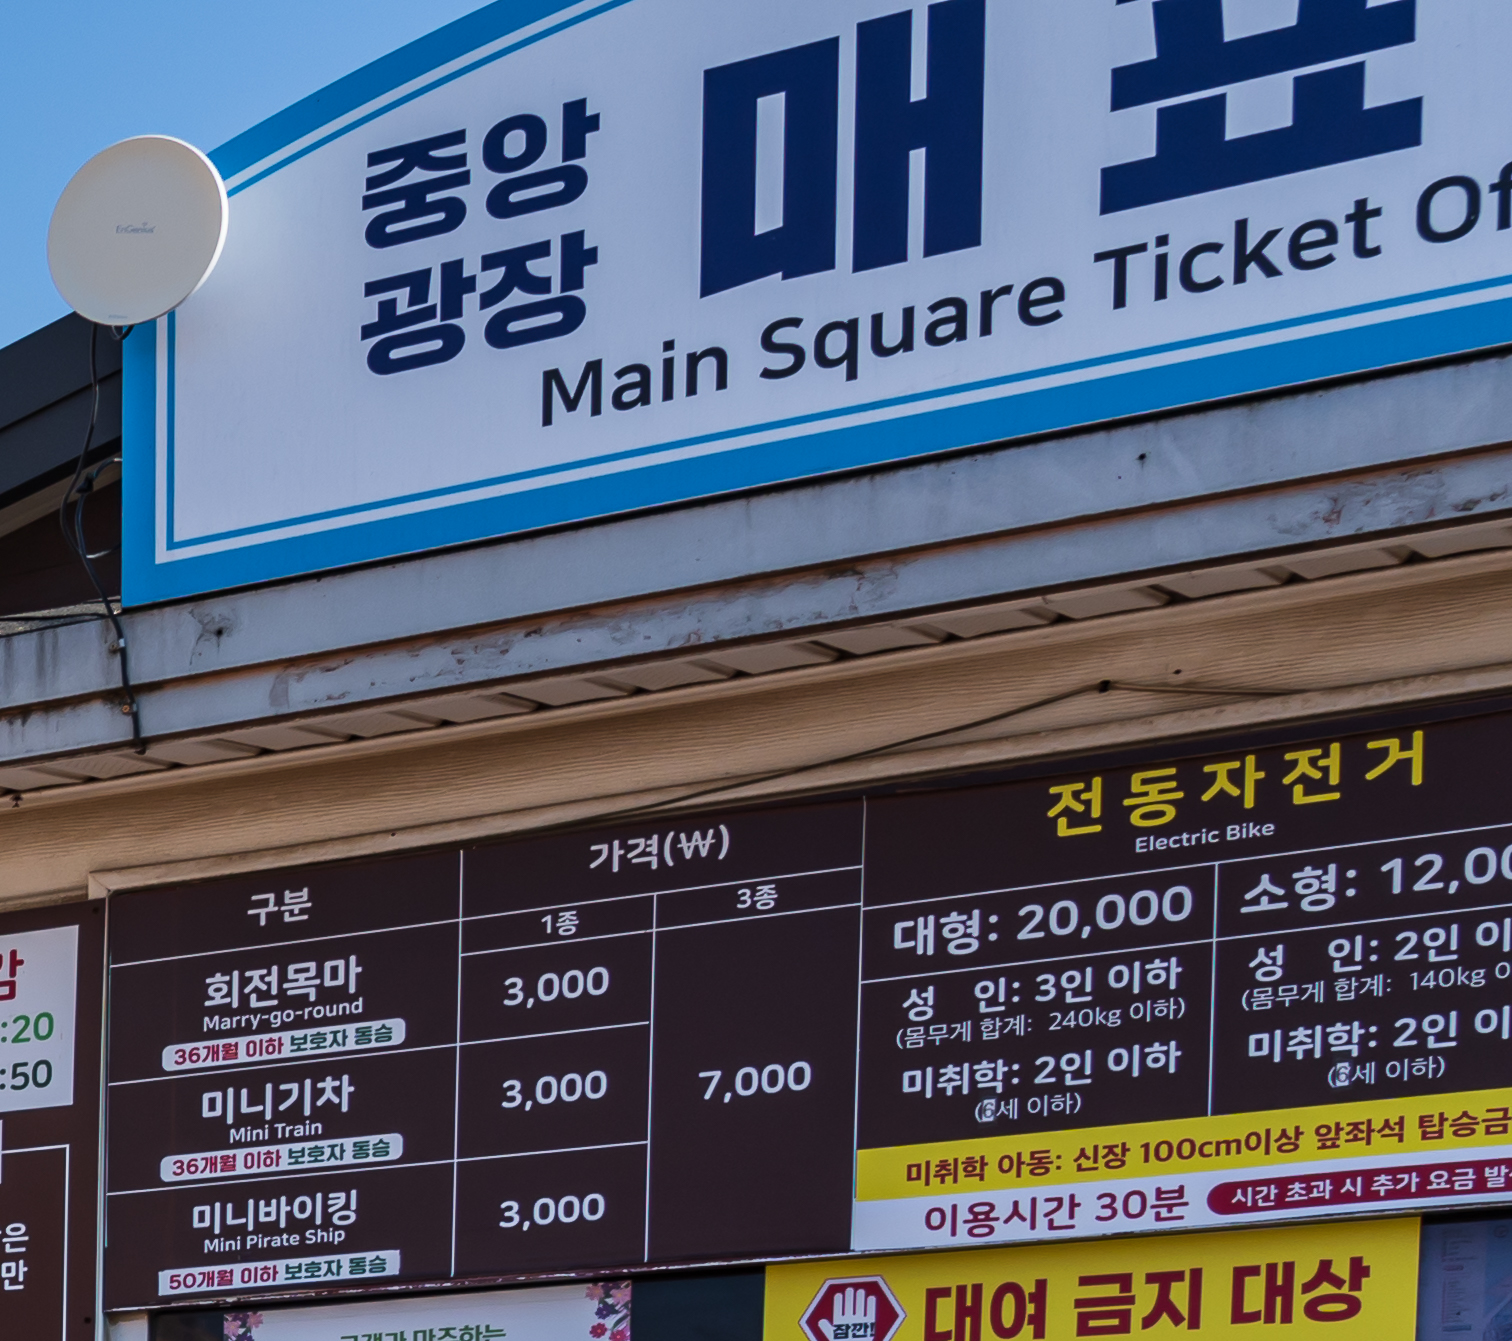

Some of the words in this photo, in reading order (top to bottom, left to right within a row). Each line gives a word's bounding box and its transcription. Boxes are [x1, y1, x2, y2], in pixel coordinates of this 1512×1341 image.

[360, 97, 600, 251] 중앙
[359, 230, 598, 377] 광장
[540, 340, 729, 428] Main
[757, 272, 1066, 379] Square
[1093, 194, 1383, 311] Ticket
[1047, 730, 1423, 837] 전동자전거
[1135, 827, 1220, 853] Electric
[1225, 821, 1276, 842] Bike
[247, 888, 312, 926] 구분
[737, 884, 778, 910] 3종
[1240, 863, 1356, 912] 소형:
[541, 911, 579, 935] 1종
[893, 909, 998, 956] 대형:
[1016, 885, 1192, 941] 20,000
[204, 955, 362, 1008] 회전목마
[503, 966, 610, 1009] 3,000
[902, 985, 935, 1022] 성
[1035, 967, 1093, 1003] 3인
[1108, 956, 1182, 994] 이하
[203, 998, 363, 1032] Marry-go-round
[896, 1020, 972, 1049] (몸무게
[980, 1014, 1032, 1041] 합계:
[1049, 1008, 1121, 1032] 240kg
[1130, 997, 1186, 1022] 이하)
[174, 1042, 239, 1066] 36개월
[245, 1036, 283, 1058] 이하
[289, 1028, 348, 1054] 보호자
[354, 1023, 393, 1045] 동승
[501, 1070, 607, 1111] 3,000
[699, 1060, 811, 1103] 7,000
[902, 1058, 1020, 1099] 미취학:
[1034, 1049, 1092, 1086] 2인
[1107, 1041, 1182, 1078] 이하
[202, 1074, 354, 1124] 미니기차
[1027, 1092, 1082, 1118] 이하)
[230, 1125, 269, 1143] Mini
[274, 1121, 322, 1139] Train
[192, 1189, 358, 1234] 미니바이킹
[499, 1193, 605, 1231] 3,000
[925, 1193, 1081, 1239] 이용시간
[1095, 1184, 1190, 1222] 30분
[204, 1236, 241, 1253] Mini
[246, 1232, 300, 1250] Pirate
[305, 1228, 345, 1246] Ship
[1073, 1267, 1203, 1337] 금지
[1230, 1255, 1371, 1323] 대상
[833, 1322, 875, 1340] 잠깐!
